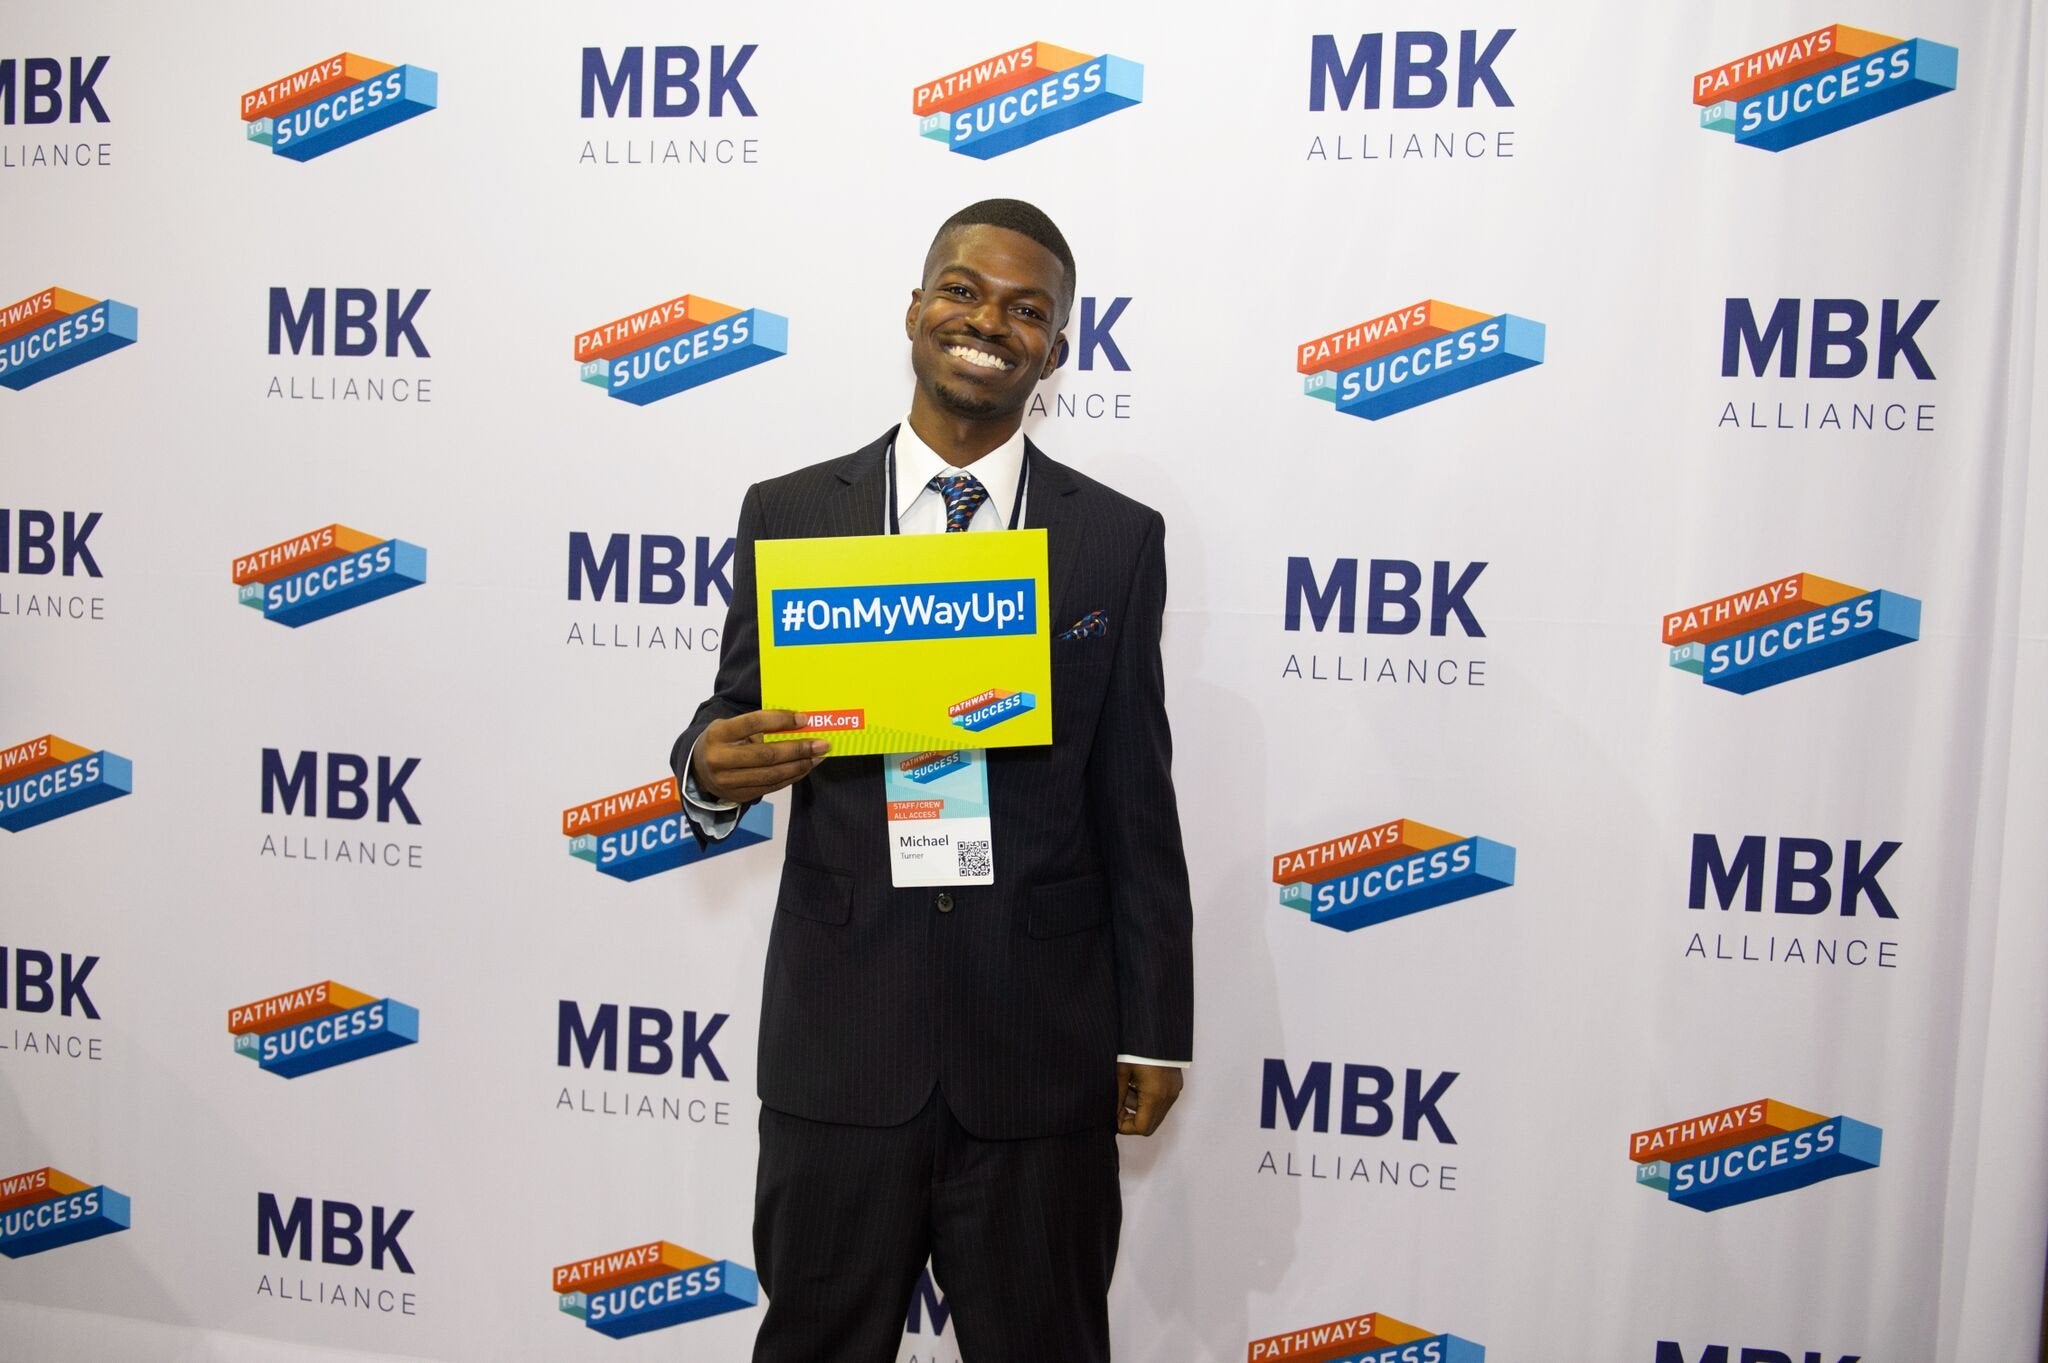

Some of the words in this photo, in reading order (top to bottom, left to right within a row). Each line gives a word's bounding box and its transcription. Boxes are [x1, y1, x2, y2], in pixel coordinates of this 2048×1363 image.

[581, 44, 758, 118] MBK
[917, 48, 1033, 107] PATHWAYS
[1309, 29, 1516, 111] MBK
[1699, 31, 1832, 96] PATHWAYS
[245, 58, 342, 112] PATHWAYS
[955, 63, 1101, 141] SUCCESS
[1742, 48, 1909, 131] SUCCESS
[249, 121, 263, 135] TO
[277, 73, 401, 144] SUCCESS
[921, 116, 938, 131] TO
[1704, 106, 1722, 122] TO
[4, 144, 111, 167] LIANCE
[580, 140, 758, 163] ALLIANCE
[1307, 132, 1514, 160] ALLIANCE
[0, 292, 52, 327] HWAYS
[268, 287, 431, 358] MBK
[579, 301, 685, 353] PATHWAYS
[613, 317, 749, 387] SUCCESS
[1303, 306, 1426, 365] PATHWAYS
[1722, 298, 1940, 380] MBK
[582, 363, 599, 378] TO
[1307, 375, 1324, 390] TO
[1342, 323, 1500, 401] SUCCESS
[267, 376, 431, 402] ALLIANCE
[1028, 393, 1131, 418] ANCE
[1719, 402, 1936, 431] ALLIANCE
[0, 509, 103, 578] BK
[236, 529, 333, 577] PATHWAYS
[268, 546, 391, 610] SUCCESS
[568, 532, 736, 607] MBK
[0, 593, 104, 619] LIANCE
[241, 587, 254, 598] TO
[782, 591, 1024, 635] #OnMyWayUp!
[1285, 557, 1488, 638] MBK
[1669, 579, 1798, 635] PATHWAYS
[567, 622, 719, 651] ALLIANC
[1673, 646, 1691, 662] TO
[1710, 599, 1873, 673] SUCCESS
[1282, 655, 1486, 686] ALLIANCE
[950, 690, 994, 714] PATHWAYS
[965, 695, 1021, 726] SUCCESS
[0, 740, 47, 770] WAYS
[914, 753, 959, 778] SUCCESS
[261, 748, 421, 825] MBK
[567, 782, 671, 827] PATHWAYS
[909, 811, 936, 819] ACCESS
[261, 835, 421, 868] ALLIANCE
[571, 838, 586, 850] TO
[602, 815, 694, 862] SUCCE
[900, 834, 949, 847] Michael
[1279, 825, 1399, 875] PATHWAYS
[1283, 886, 1299, 900] TO
[1318, 845, 1470, 912] SUCCESS
[1689, 833, 1903, 919] MBK
[1685, 933, 1898, 968] ALLIANCE
[0, 946, 101, 1020] BK
[232, 986, 326, 1027] PATHWAYS
[0, 1030, 101, 1060] IANCE
[237, 1037, 249, 1048] TO
[264, 1005, 383, 1060] SUCCESS
[557, 1000, 730, 1082] MBK
[557, 1088, 729, 1125] ALLIANCE
[1260, 1058, 1460, 1145] MBK
[1636, 1104, 1762, 1153] PATHWAYS
[1258, 1151, 1457, 1190] ALLIANCE
[1639, 1165, 1657, 1178] TO
[1676, 1125, 1834, 1191] SUCCESS
[0, 1172, 46, 1196] WAYS
[0, 1192, 98, 1238] UCCESS
[257, 1192, 415, 1274] MBK
[557, 1246, 659, 1285] PATHWAYS
[257, 1275, 415, 1315] ALLIANCE
[562, 1295, 576, 1307] TO
[591, 1266, 720, 1319] SUCCESS
[1253, 1318, 1371, 1360] PATHWAYS
